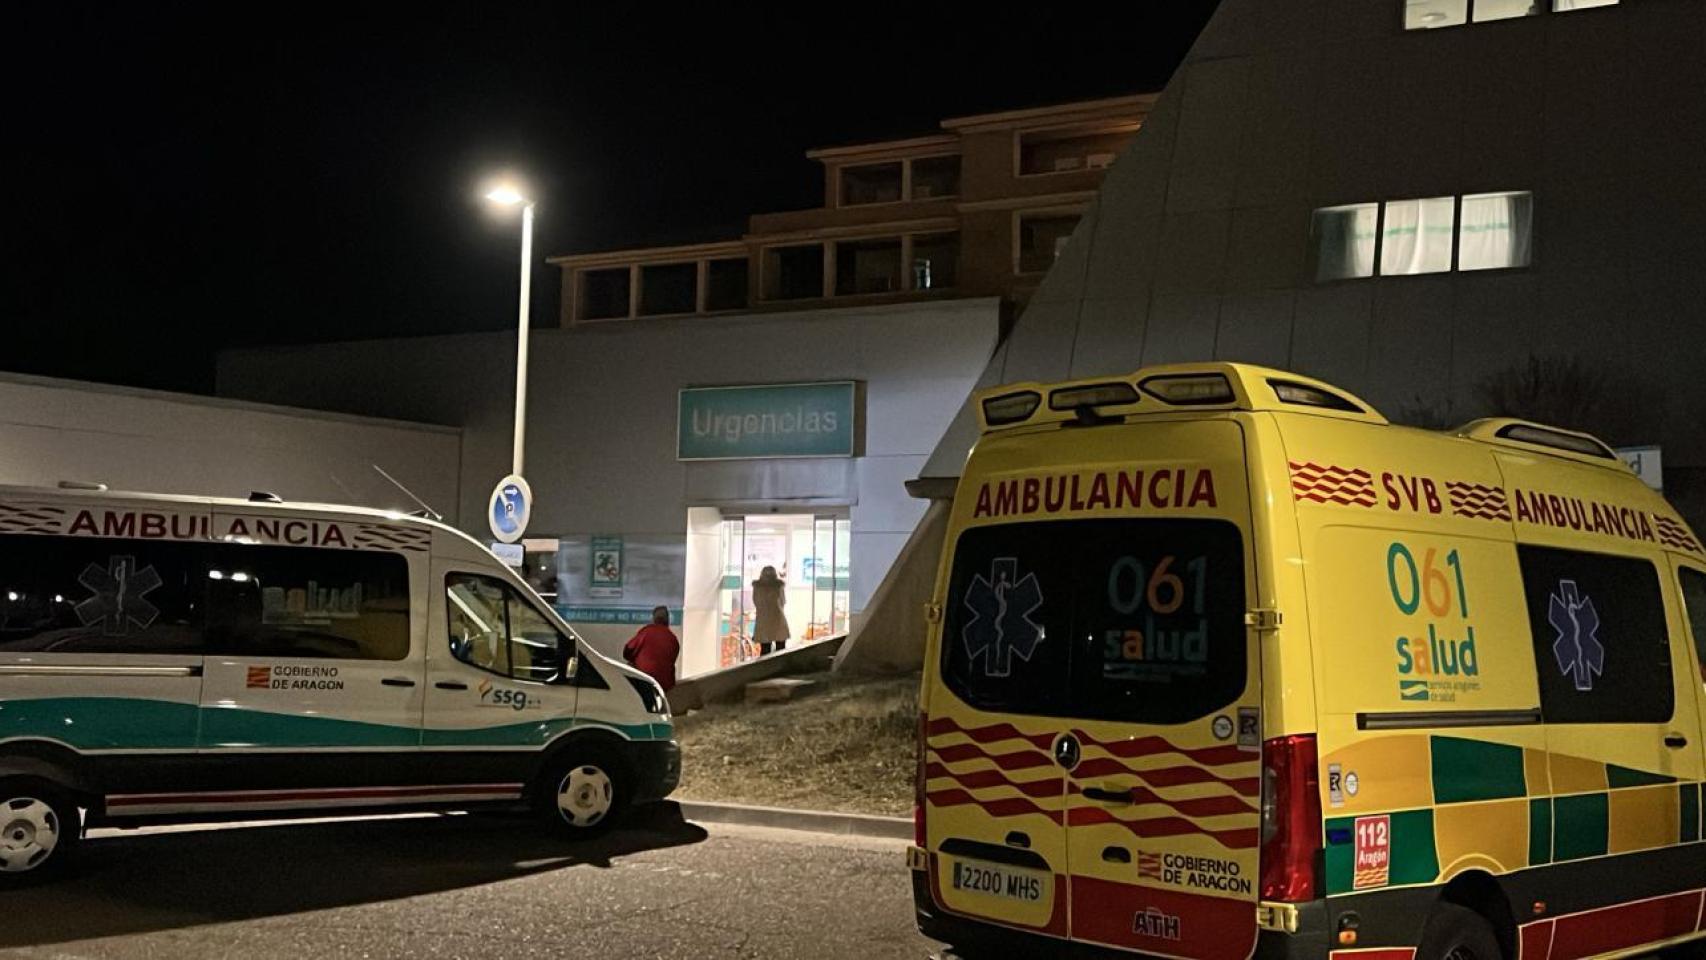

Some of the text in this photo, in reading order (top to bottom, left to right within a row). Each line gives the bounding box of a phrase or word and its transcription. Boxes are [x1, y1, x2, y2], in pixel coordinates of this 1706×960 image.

[692, 408, 838, 443] Urgencias
[974, 469, 1218, 518] AMBULANCIA
[1382, 472, 1442, 513] SVB
[1515, 489, 1655, 542] AMBULANCIA
[1108, 554, 1207, 615] 061
[1387, 542, 1468, 619] 061
[1104, 614, 1208, 662] salud
[1397, 624, 1478, 676] salud
[272, 680, 344, 690] DE ARAGON
[274, 666, 338, 677] GOBIERNO
[493, 689, 526, 711] ssg
[1358, 822, 1388, 848] 112
[1163, 854, 1240, 876] GOBIERNO
[1358, 851, 1388, 867] Aragón
[963, 867, 1040, 900] 2200 MHS
[1163, 869, 1251, 894] DE ARAGON
[1134, 911, 1180, 940] ATH
